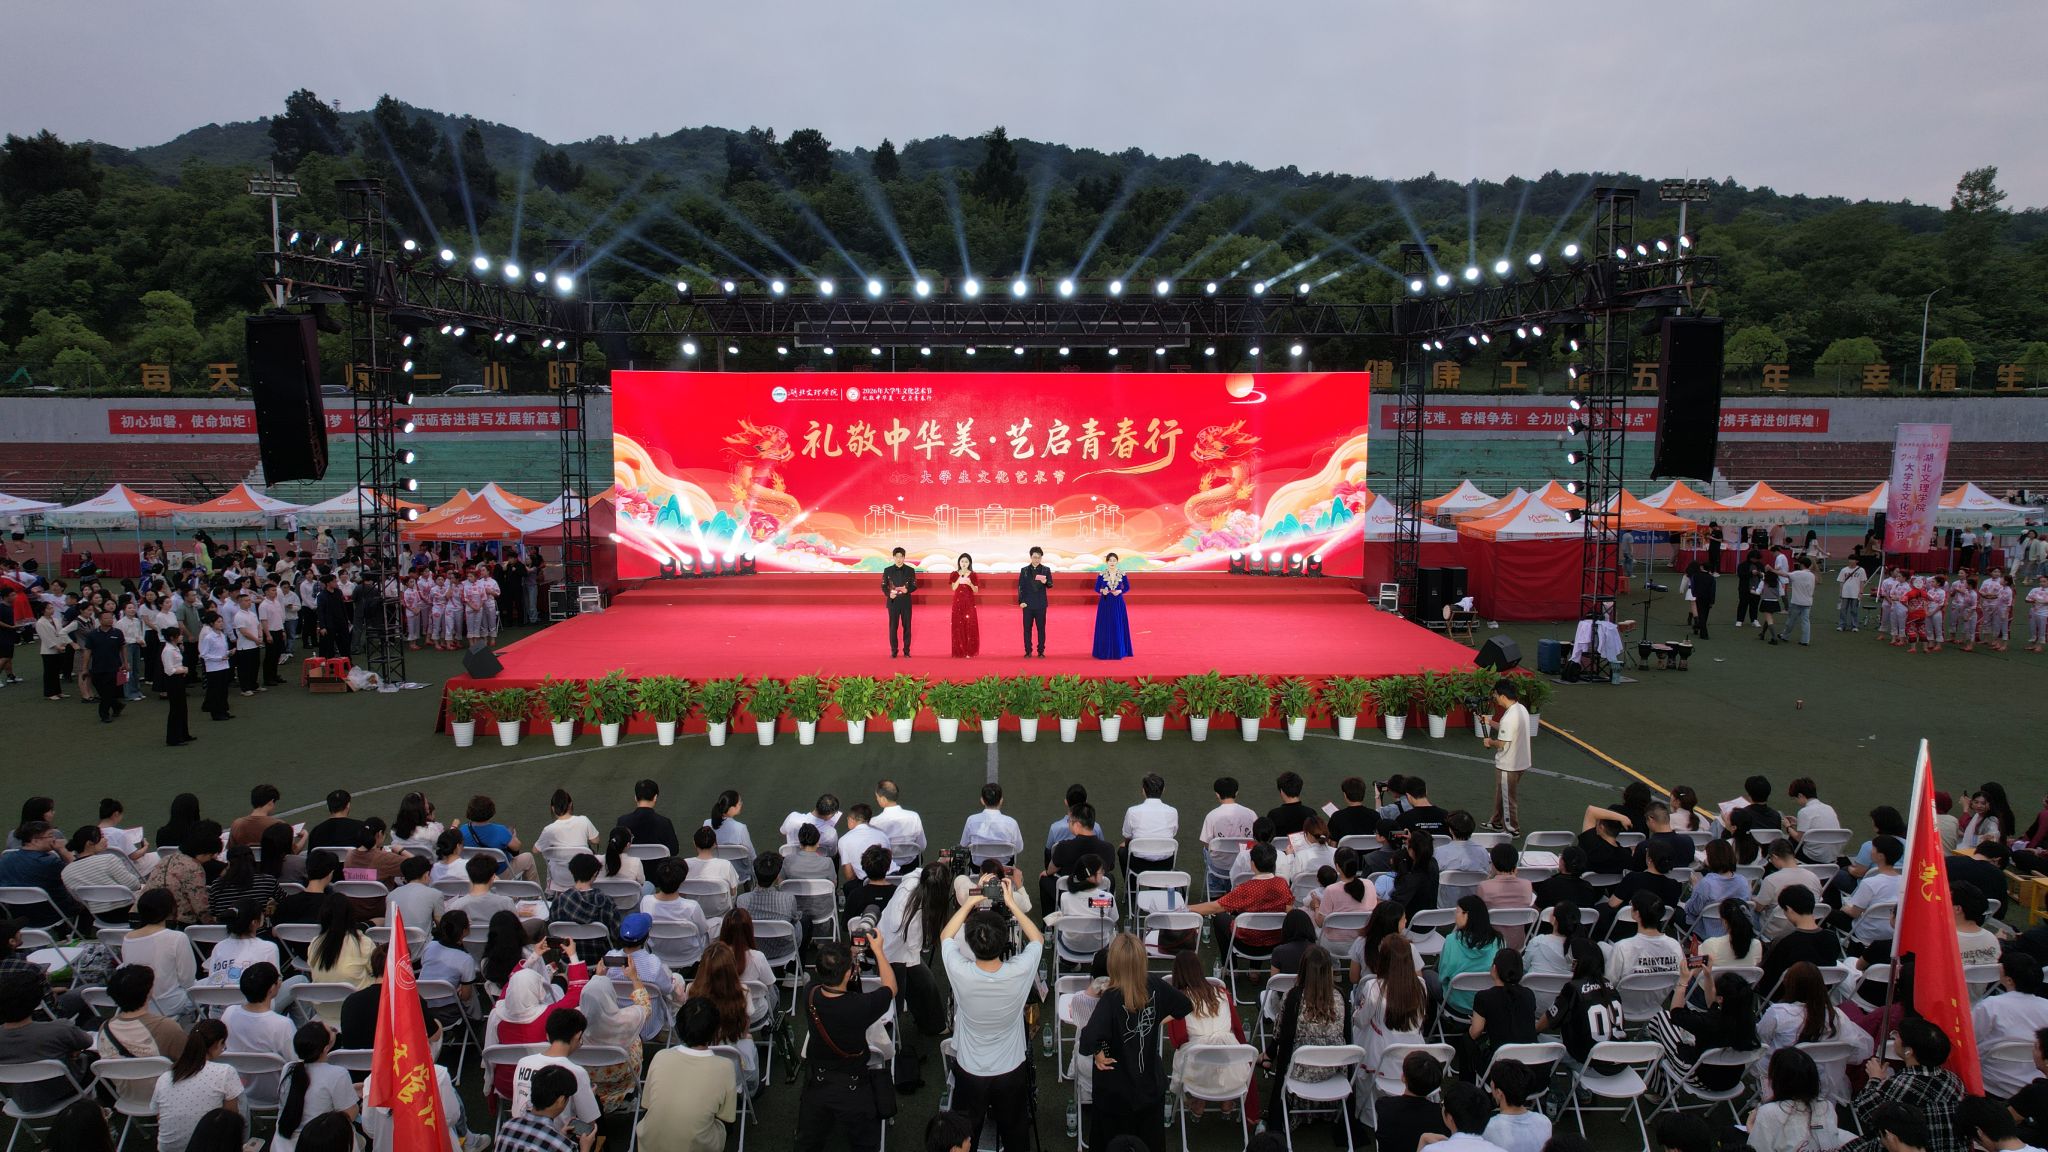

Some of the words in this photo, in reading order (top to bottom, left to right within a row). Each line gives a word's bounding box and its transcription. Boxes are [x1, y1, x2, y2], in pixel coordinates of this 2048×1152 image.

[802, 418, 1184, 466] 礼敬中华美·艺启青春行
[1718, 413, 1819, 428] 携手奋进创辉煌！
[920, 470, 1065, 484] 大学生文化艺术节
[1896, 463, 1915, 539] 大学生文化艺术节
[1915, 453, 1934, 512] 湖北文理学院
